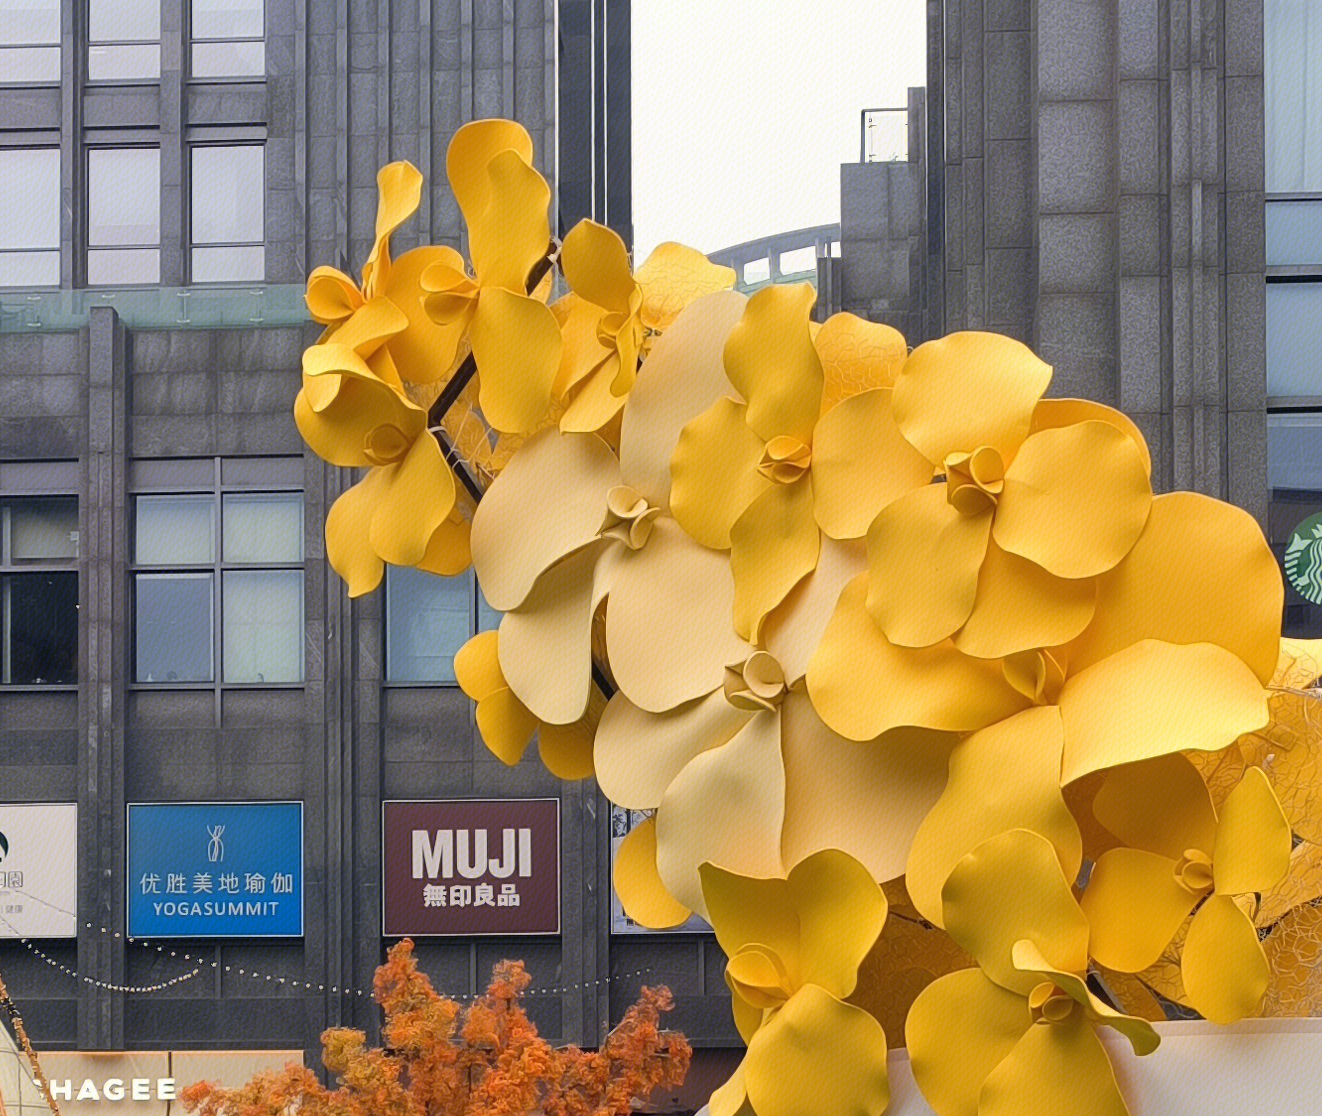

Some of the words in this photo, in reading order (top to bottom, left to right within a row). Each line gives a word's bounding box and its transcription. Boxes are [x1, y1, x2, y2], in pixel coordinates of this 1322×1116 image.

[412, 828, 532, 879] MUJI
[139, 871, 294, 895] 优胜美地瑜伽
[422, 882, 521, 908] 無印良品
[153, 901, 279, 916] YOGASUMMIT
